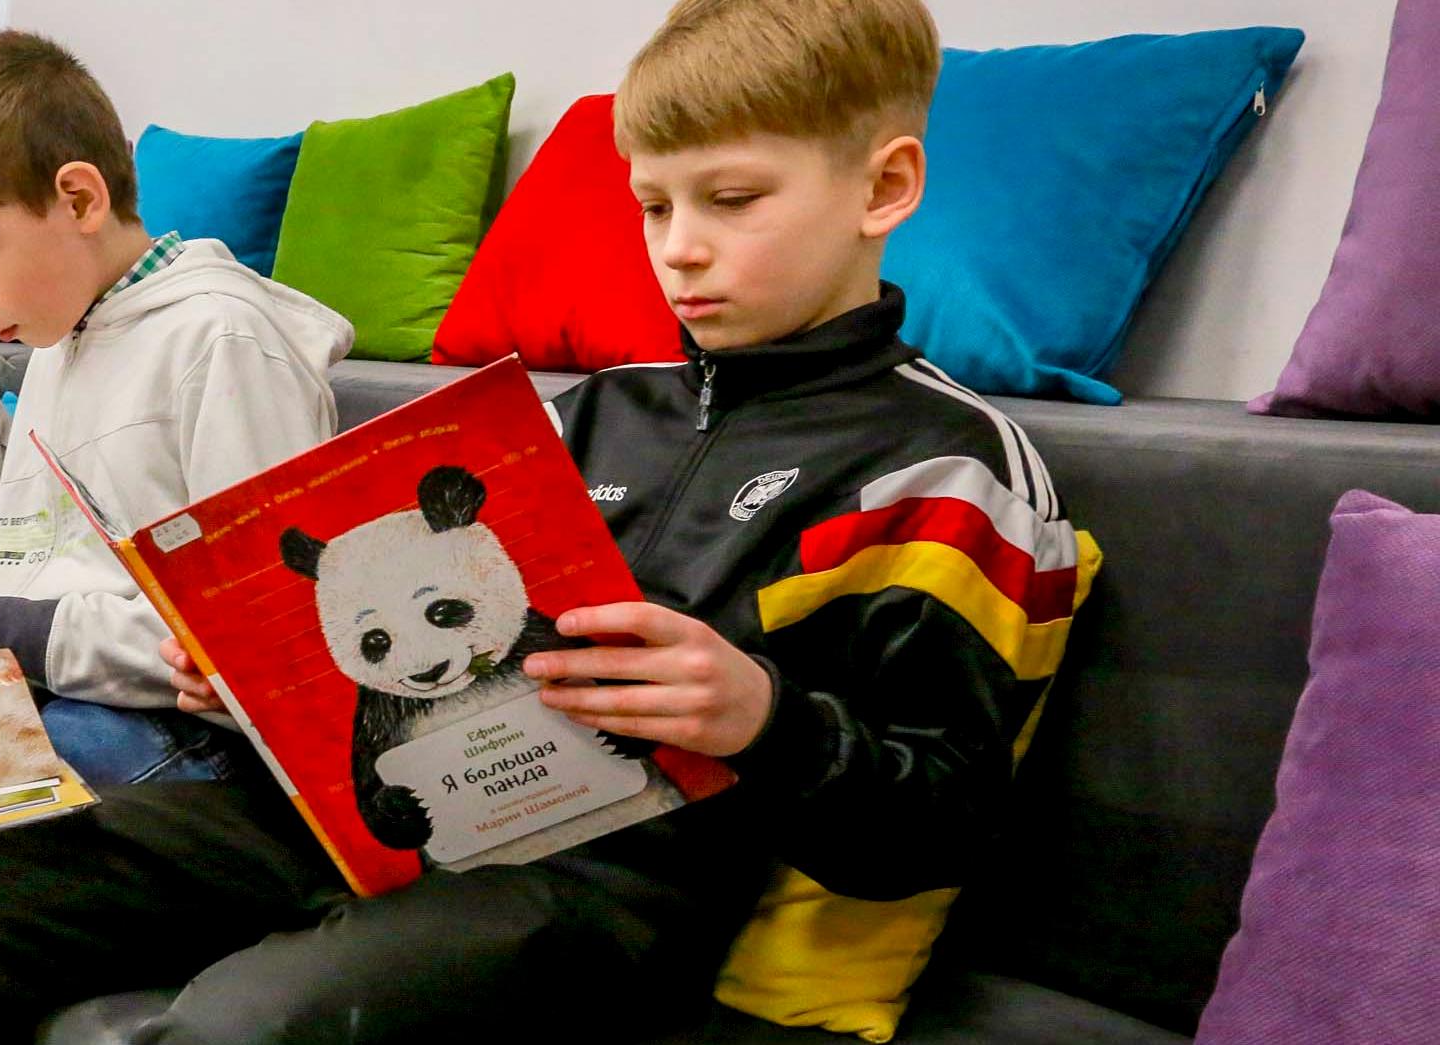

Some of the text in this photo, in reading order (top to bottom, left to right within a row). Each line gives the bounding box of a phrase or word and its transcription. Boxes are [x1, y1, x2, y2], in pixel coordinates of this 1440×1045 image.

[464, 730, 525, 759] Шифрин
[466, 722, 507, 743] Ефим
[442, 741, 558, 794] Я большая
[484, 764, 549, 797] панда
[475, 785, 591, 834] Марии Шамовой
